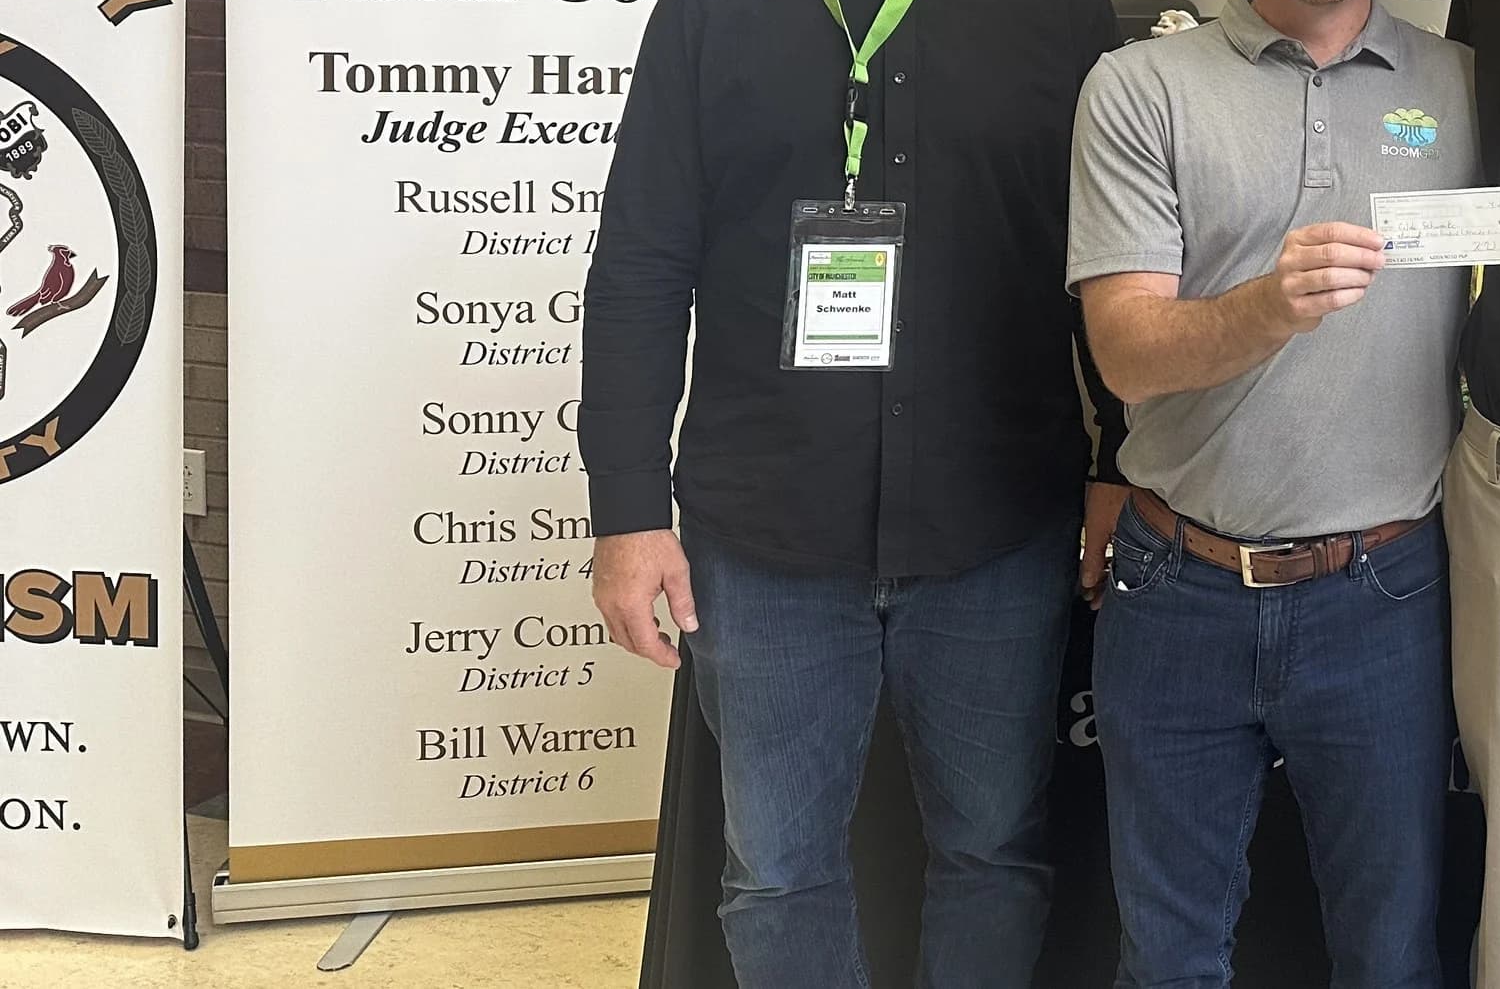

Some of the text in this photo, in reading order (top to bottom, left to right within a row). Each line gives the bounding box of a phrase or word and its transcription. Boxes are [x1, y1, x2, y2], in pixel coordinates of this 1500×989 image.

[309, 51, 513, 107] Tommy
[361, 110, 488, 153] Judge
[5, 140, 35, 162] 1889
[394, 180, 535, 214] Russell
[459, 229, 597, 256] District 1
[816, 305, 871, 314] Schwenke
[832, 290, 857, 299] Matt
[415, 291, 536, 334] Sonya
[459, 341, 573, 366] District
[422, 401, 545, 442] Sonny
[459, 450, 571, 477] District
[413, 510, 517, 545] Chris
[459, 556, 594, 585] District 4
[406, 621, 502, 660] Jerry
[458, 661, 595, 693] District 5
[415, 721, 637, 761] Bill Warren
[458, 766, 596, 799] District 6
[0, 798, 81, 831] ON.
